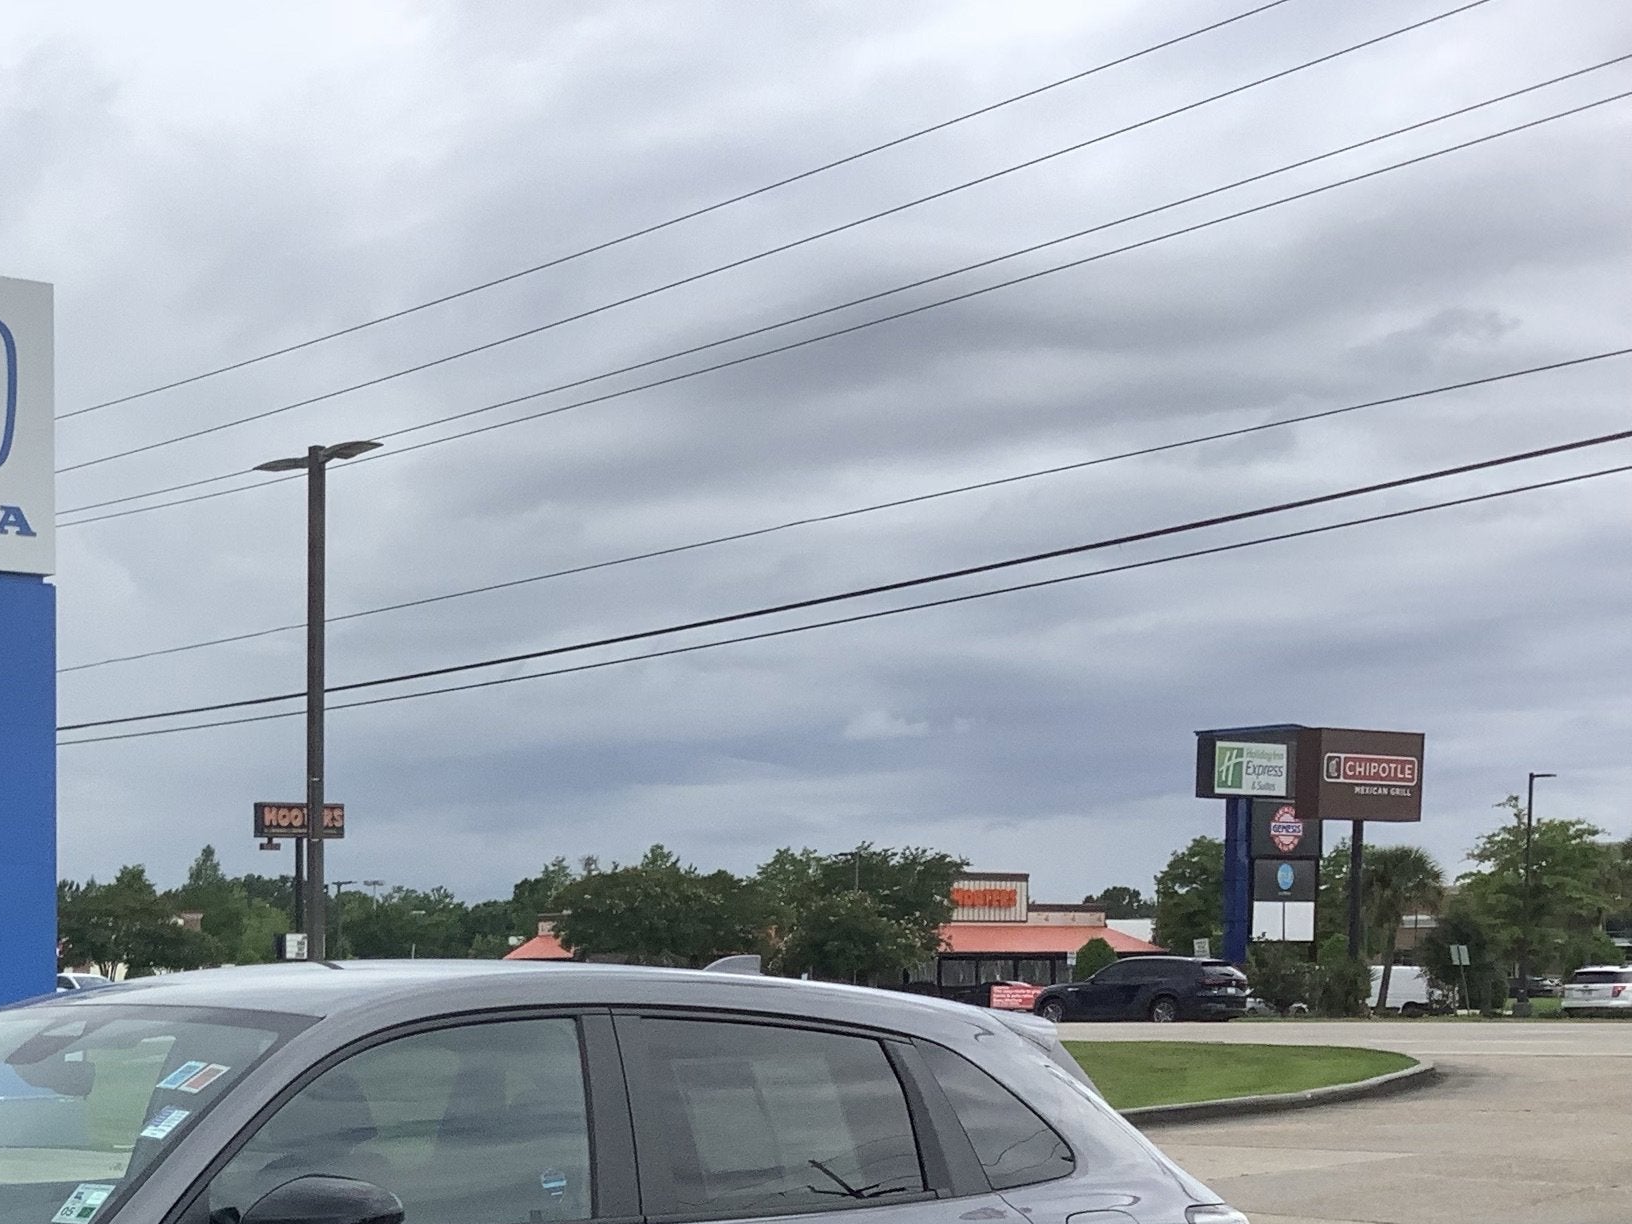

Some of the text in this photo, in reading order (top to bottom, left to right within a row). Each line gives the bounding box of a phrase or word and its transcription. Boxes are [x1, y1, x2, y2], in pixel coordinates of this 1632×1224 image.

[1245, 760, 1284, 778] Express
[1345, 761, 1413, 778] CHIPOTLE
[1354, 786, 1411, 796] MEXICAN GRILL
